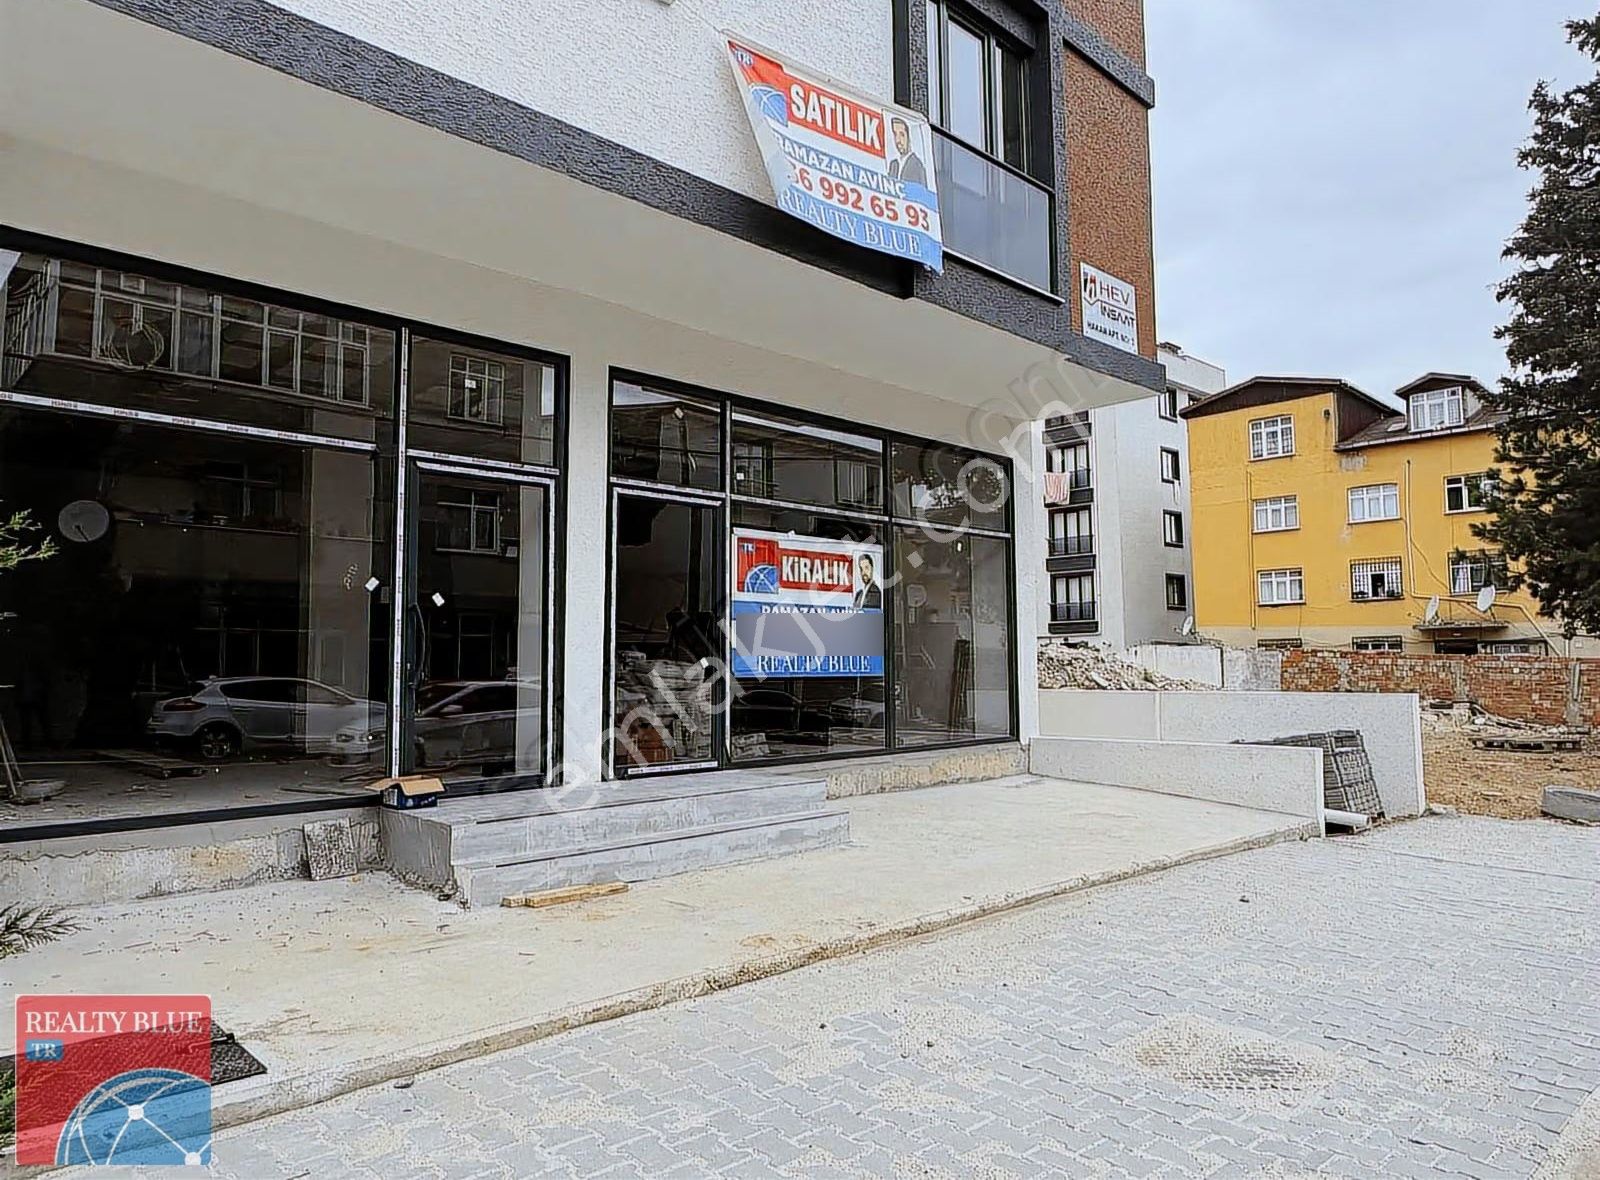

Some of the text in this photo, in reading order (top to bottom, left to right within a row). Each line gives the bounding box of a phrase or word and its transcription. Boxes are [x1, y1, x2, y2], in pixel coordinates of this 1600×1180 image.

[790, 83, 882, 151] SATILIK
[779, 187, 922, 258] REALTY BLUE
[819, 176, 864, 212] 992
[870, 195, 899, 222] 65
[905, 204, 930, 232] 93
[1099, 280, 1130, 306] HEV
[757, 655, 872, 673] REALTY BLUE
